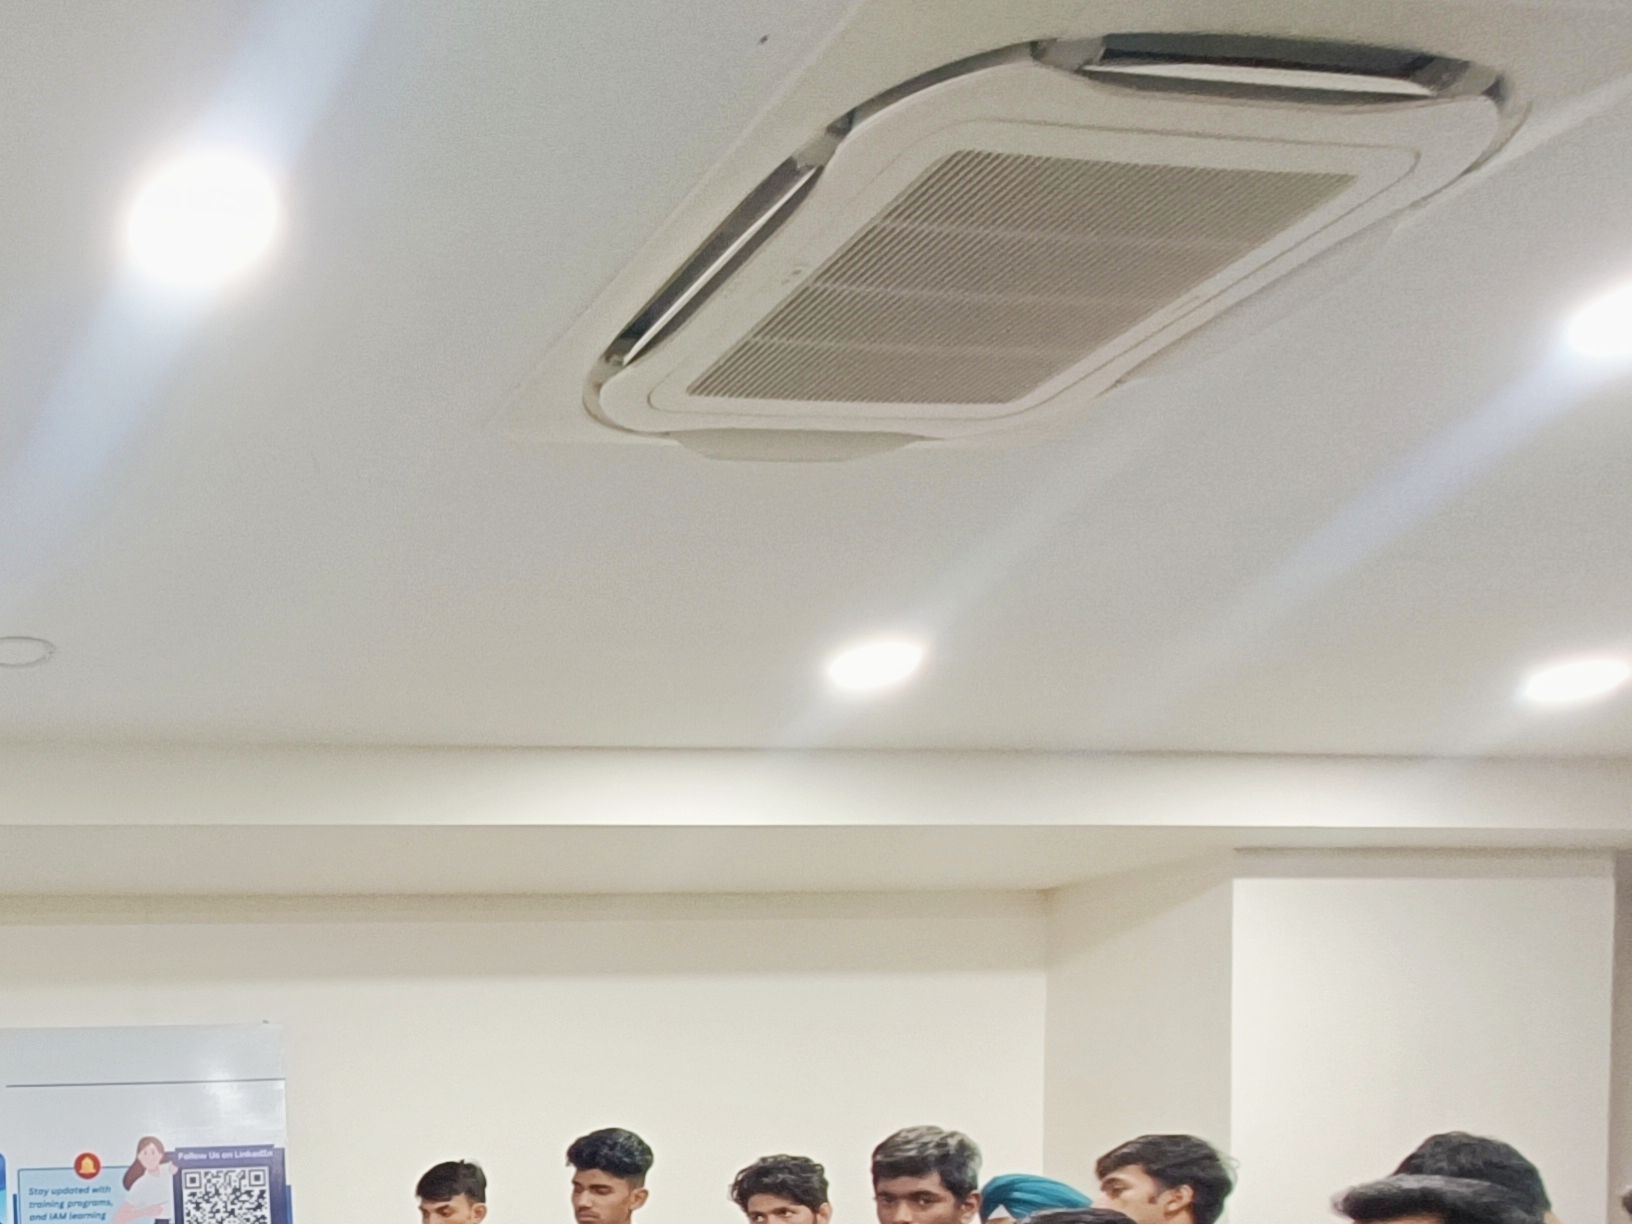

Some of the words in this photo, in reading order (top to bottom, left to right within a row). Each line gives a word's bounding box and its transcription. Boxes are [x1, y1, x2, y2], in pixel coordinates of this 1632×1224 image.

[178, 1151, 207, 1160] Follow
[209, 1151, 220, 1159] Us
[28, 1187, 49, 1197] Stay
[51, 1186, 90, 1197] updated
[92, 1185, 111, 1194] with
[29, 1199, 65, 1209] training
[67, 1199, 113, 1209] programs,
[29, 1213, 47, 1221] and
[69, 1211, 107, 1221] learning
